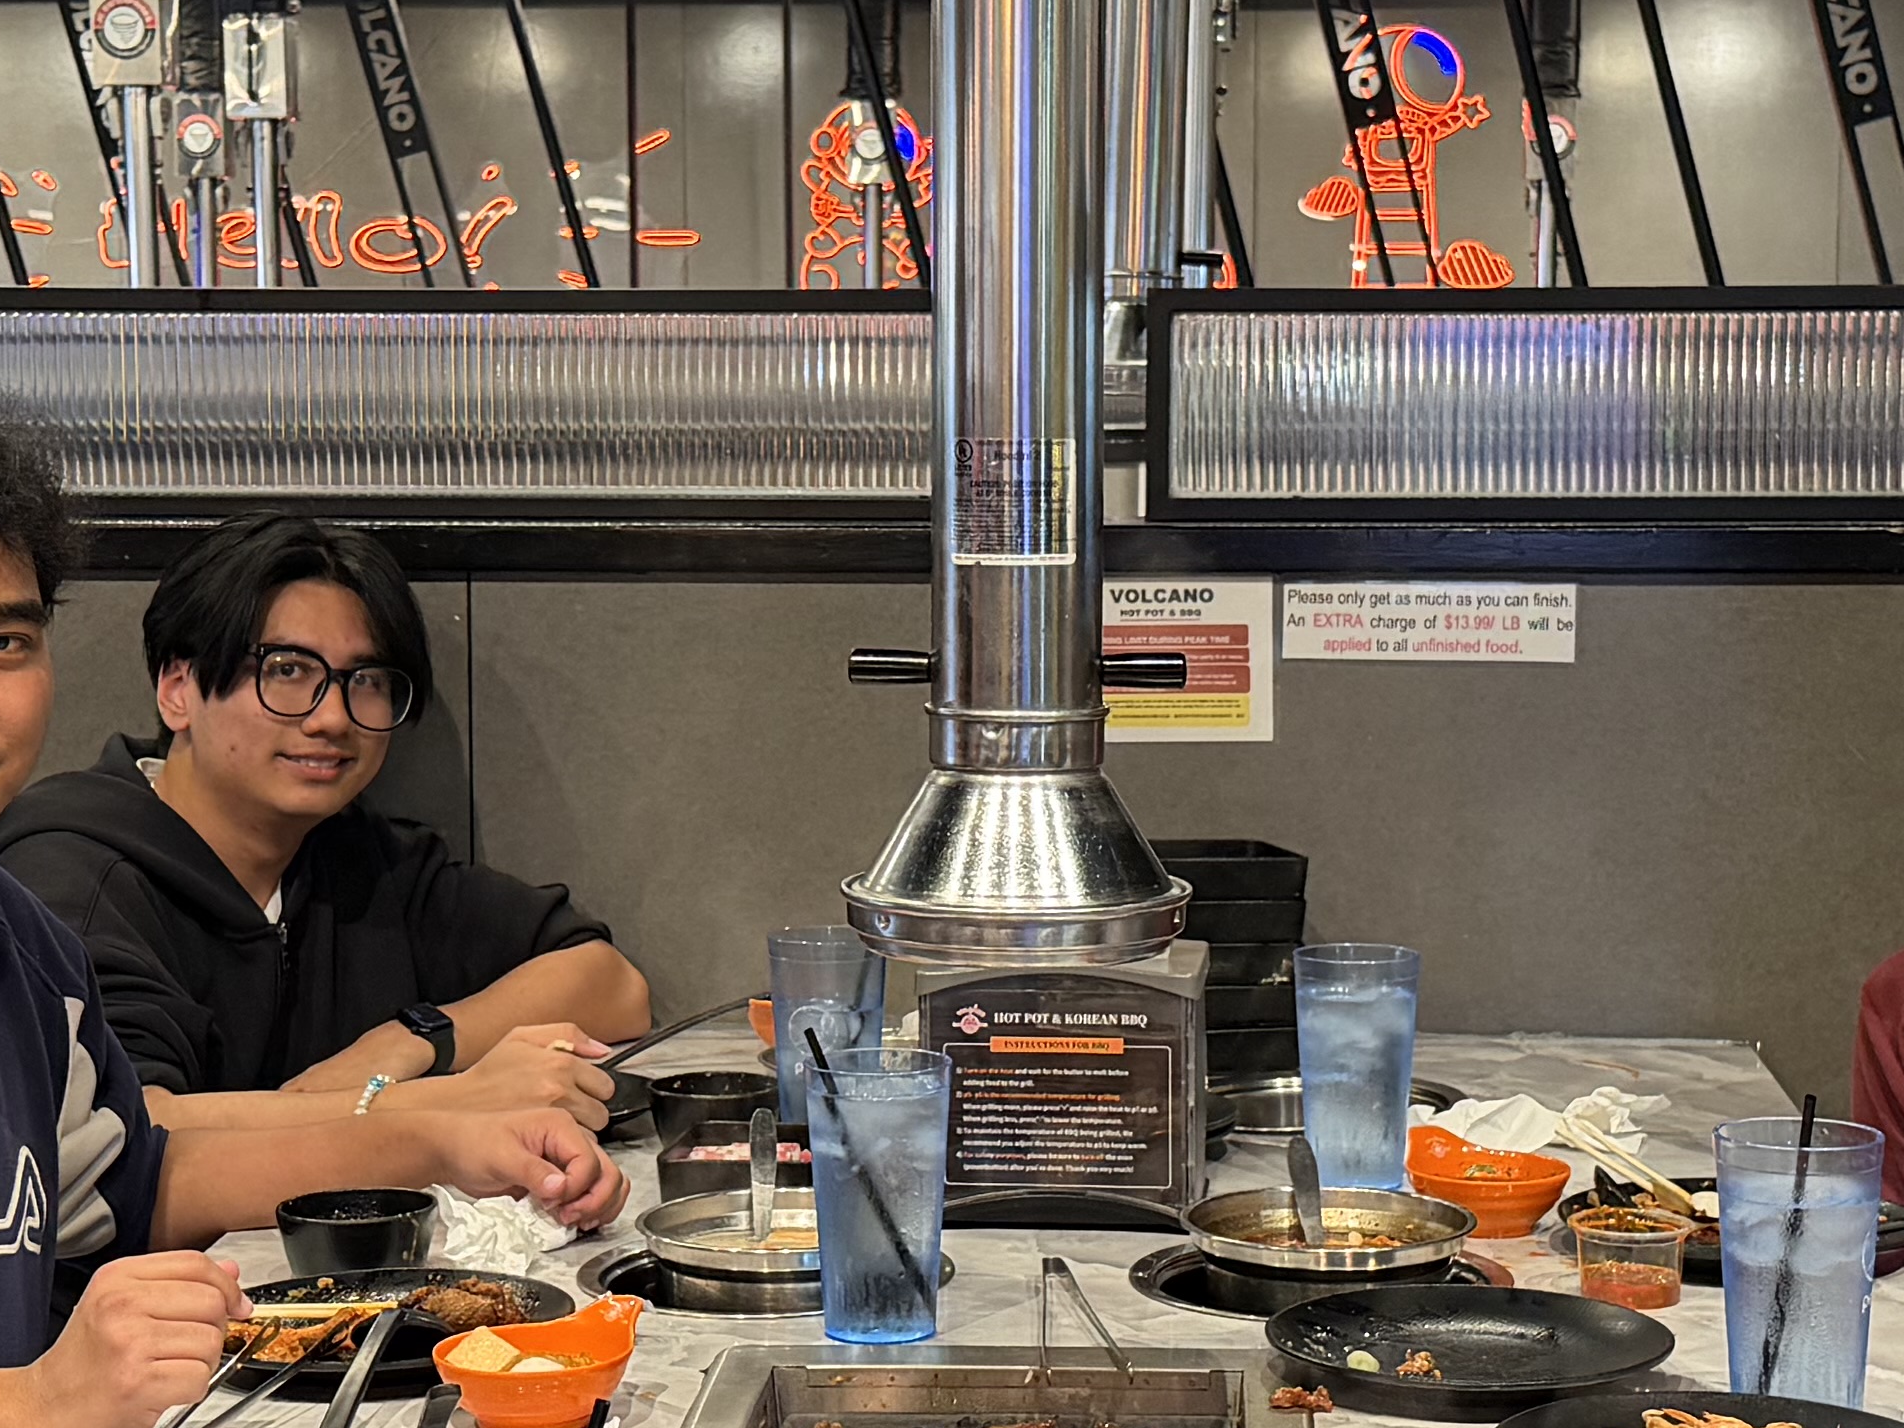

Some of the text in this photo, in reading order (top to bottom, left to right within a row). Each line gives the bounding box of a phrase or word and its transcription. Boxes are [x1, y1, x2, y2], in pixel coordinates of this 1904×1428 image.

[1110, 587, 1215, 604] VOLCANO
[1287, 589, 1572, 610] Please only get as much as you can finish.
[1120, 609, 1141, 617] HOT
[1145, 609, 1165, 617] POT
[1287, 613, 1574, 634] An EXTRA charge of $13.99/ LB will be
[1323, 637, 1523, 656] applied to all unfinished food.
[994, 1012, 1020, 1024] HOT
[1024, 1013, 1049, 1024] POT
[1065, 1014, 1118, 1025] KOREAN
[1121, 1014, 1148, 1028] BBQ
